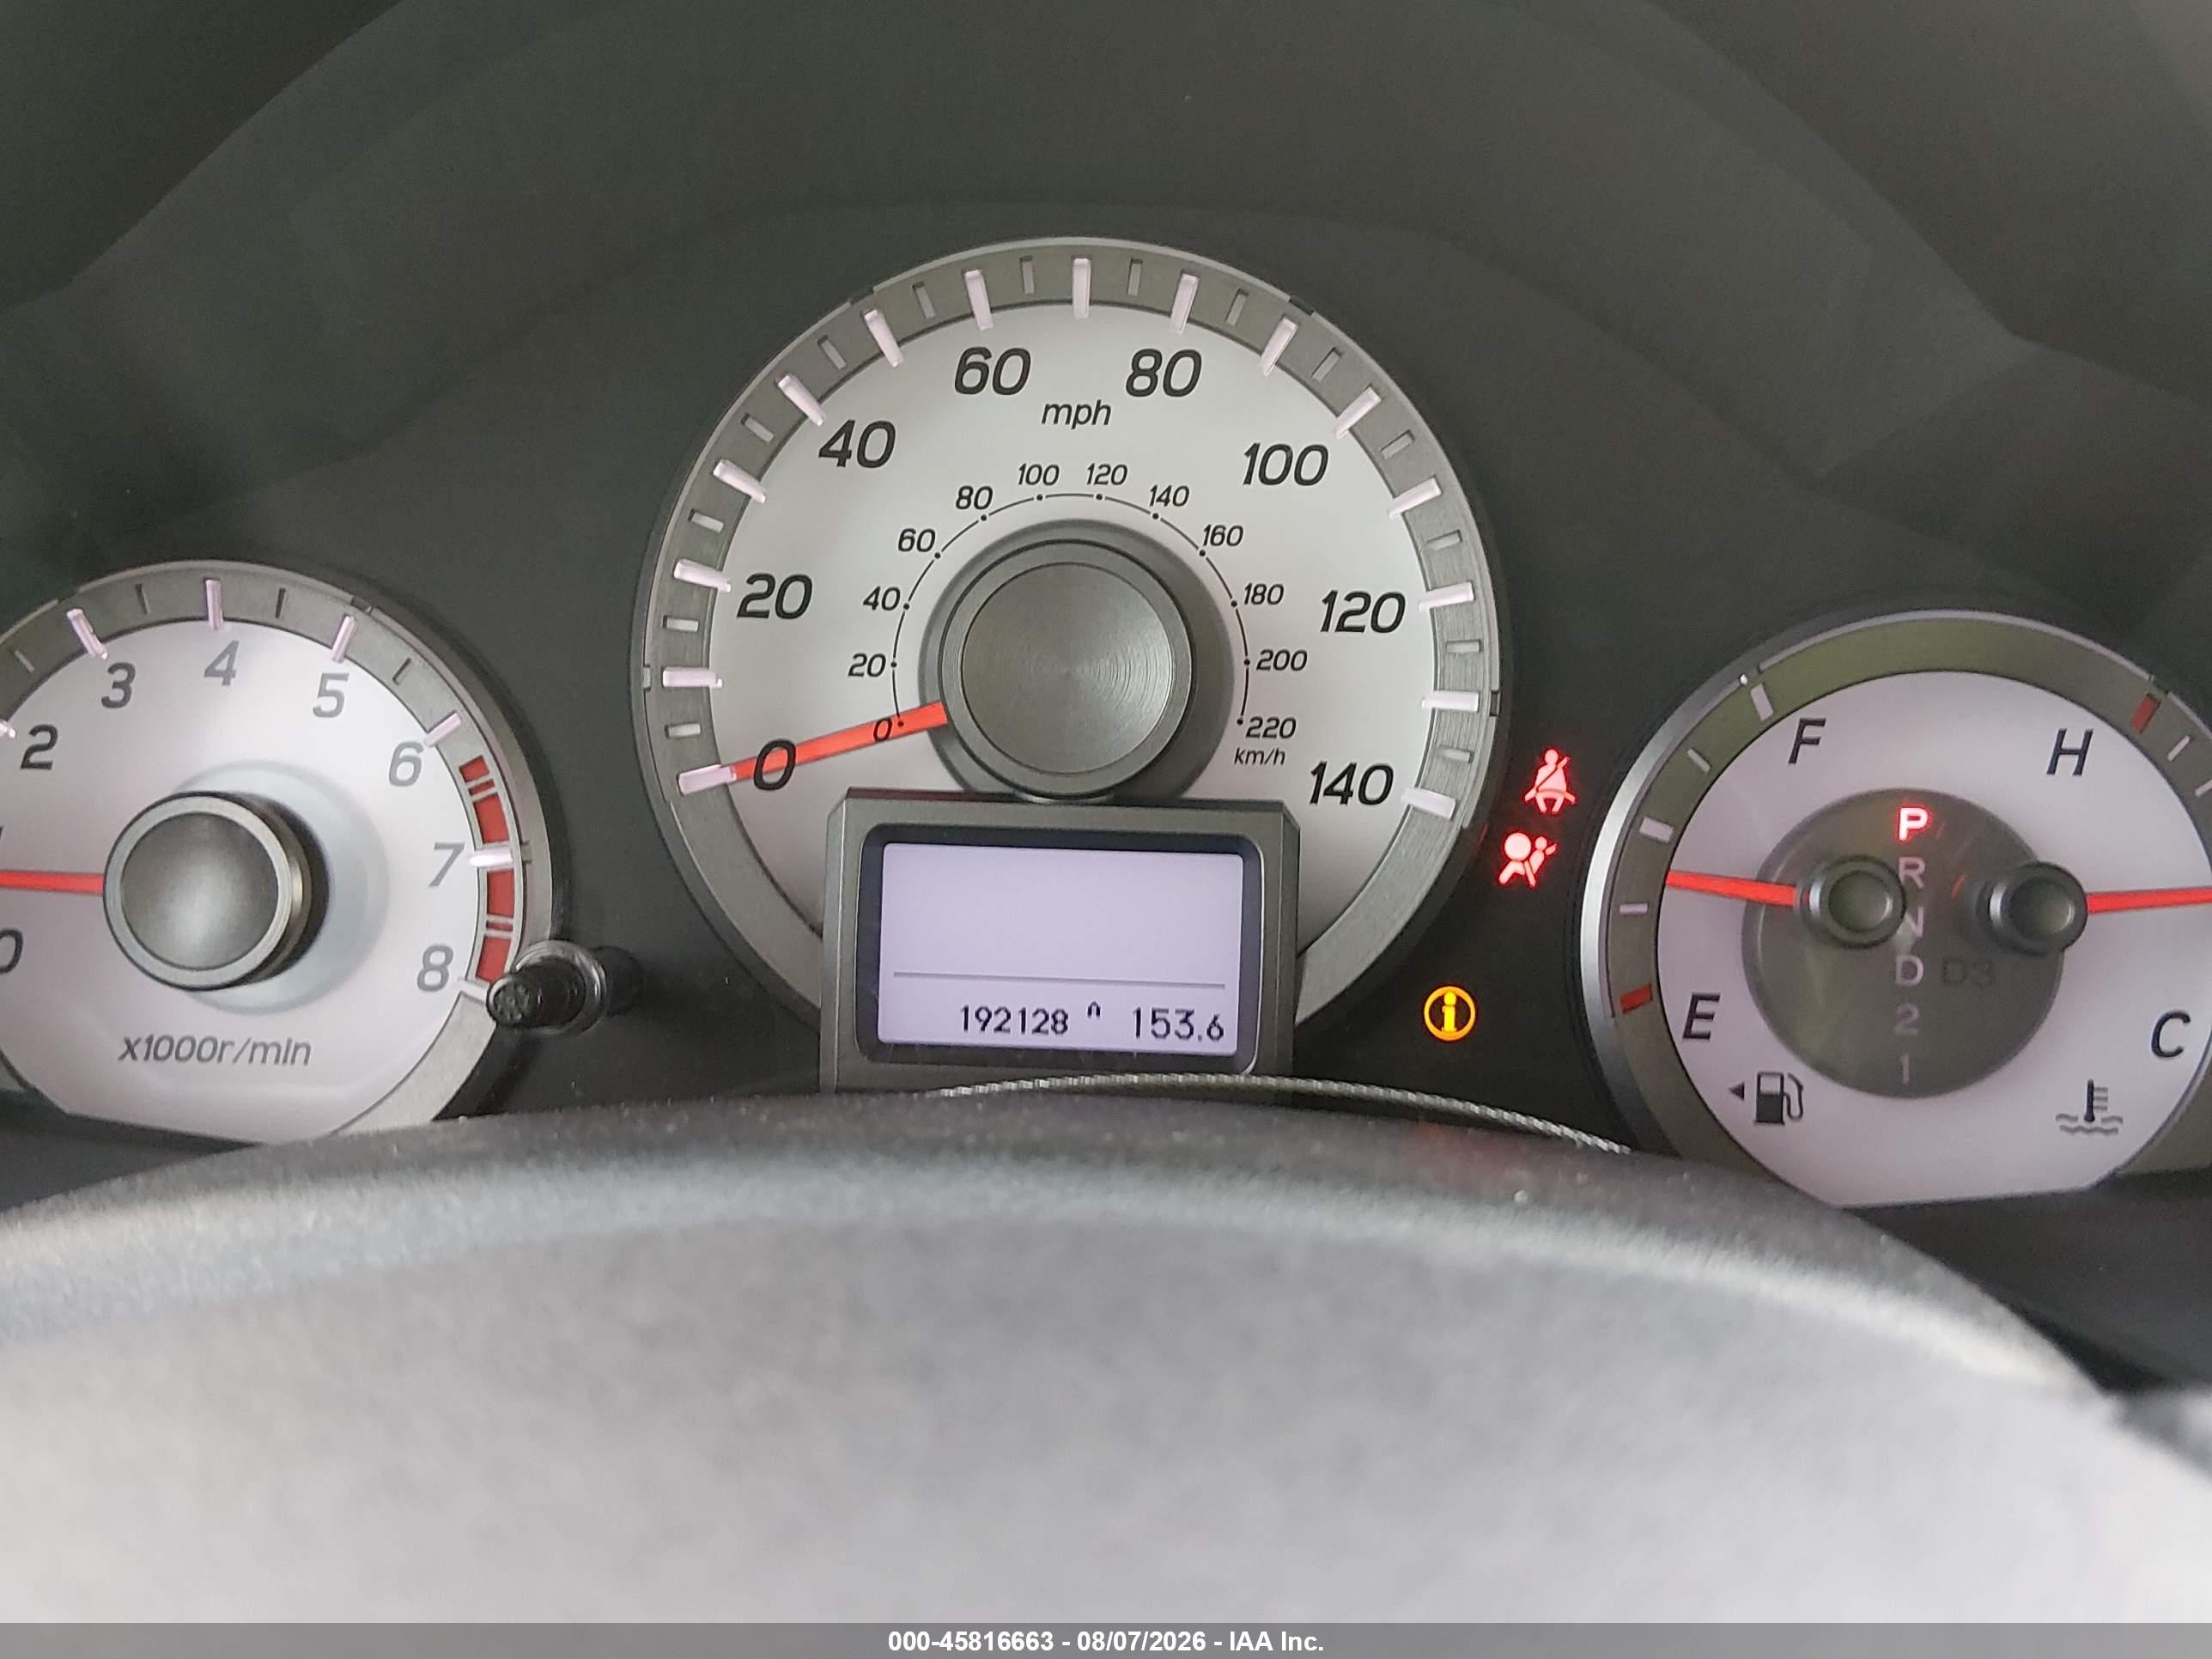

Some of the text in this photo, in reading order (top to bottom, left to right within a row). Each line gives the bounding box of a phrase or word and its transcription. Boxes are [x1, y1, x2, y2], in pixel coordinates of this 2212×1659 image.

[954, 347, 1030, 395] 60
[1126, 349, 1201, 396] 80
[1042, 399, 1111, 429] mph
[818, 421, 896, 468] 40
[1018, 464, 1059, 486] 100
[1087, 463, 1127, 485] 120
[1243, 443, 1328, 485] 100
[956, 486, 993, 509] 80
[1150, 484, 1189, 507] 140
[897, 528, 936, 552] 60
[1202, 525, 1243, 547] 160
[737, 574, 811, 618] 20
[863, 586, 900, 611] 40
[1243, 583, 1284, 605] 180
[1320, 591, 1405, 633] 120
[204, 641, 240, 686] 4
[848, 653, 886, 677] 20
[1255, 650, 1307, 672] 200
[101, 662, 136, 708] 3
[313, 673, 349, 718] 5
[872, 718, 892, 742] 0
[1246, 717, 1297, 738] 220
[1789, 718, 1826, 764] F
[21, 725, 58, 770] 2
[389, 741, 424, 787] 6
[753, 739, 796, 790] 0
[1234, 746, 1285, 766] km/h
[2046, 728, 2093, 775] H
[1310, 763, 1393, 805] 140
[1897, 806, 1929, 842] P
[429, 842, 465, 887] 7
[1899, 857, 1924, 888] R
[417, 945, 453, 992] 8
[1896, 955, 1923, 987] D
[1942, 957, 1993, 987] D3
[961, 1005, 1068, 1035] 192128
[1133, 1006, 1224, 1042] 153.6
[1682, 993, 1720, 1041] E
[1895, 1003, 1919, 1036] 2
[2151, 1011, 2191, 1058] C
[1900, 1055, 1910, 1085] 1
